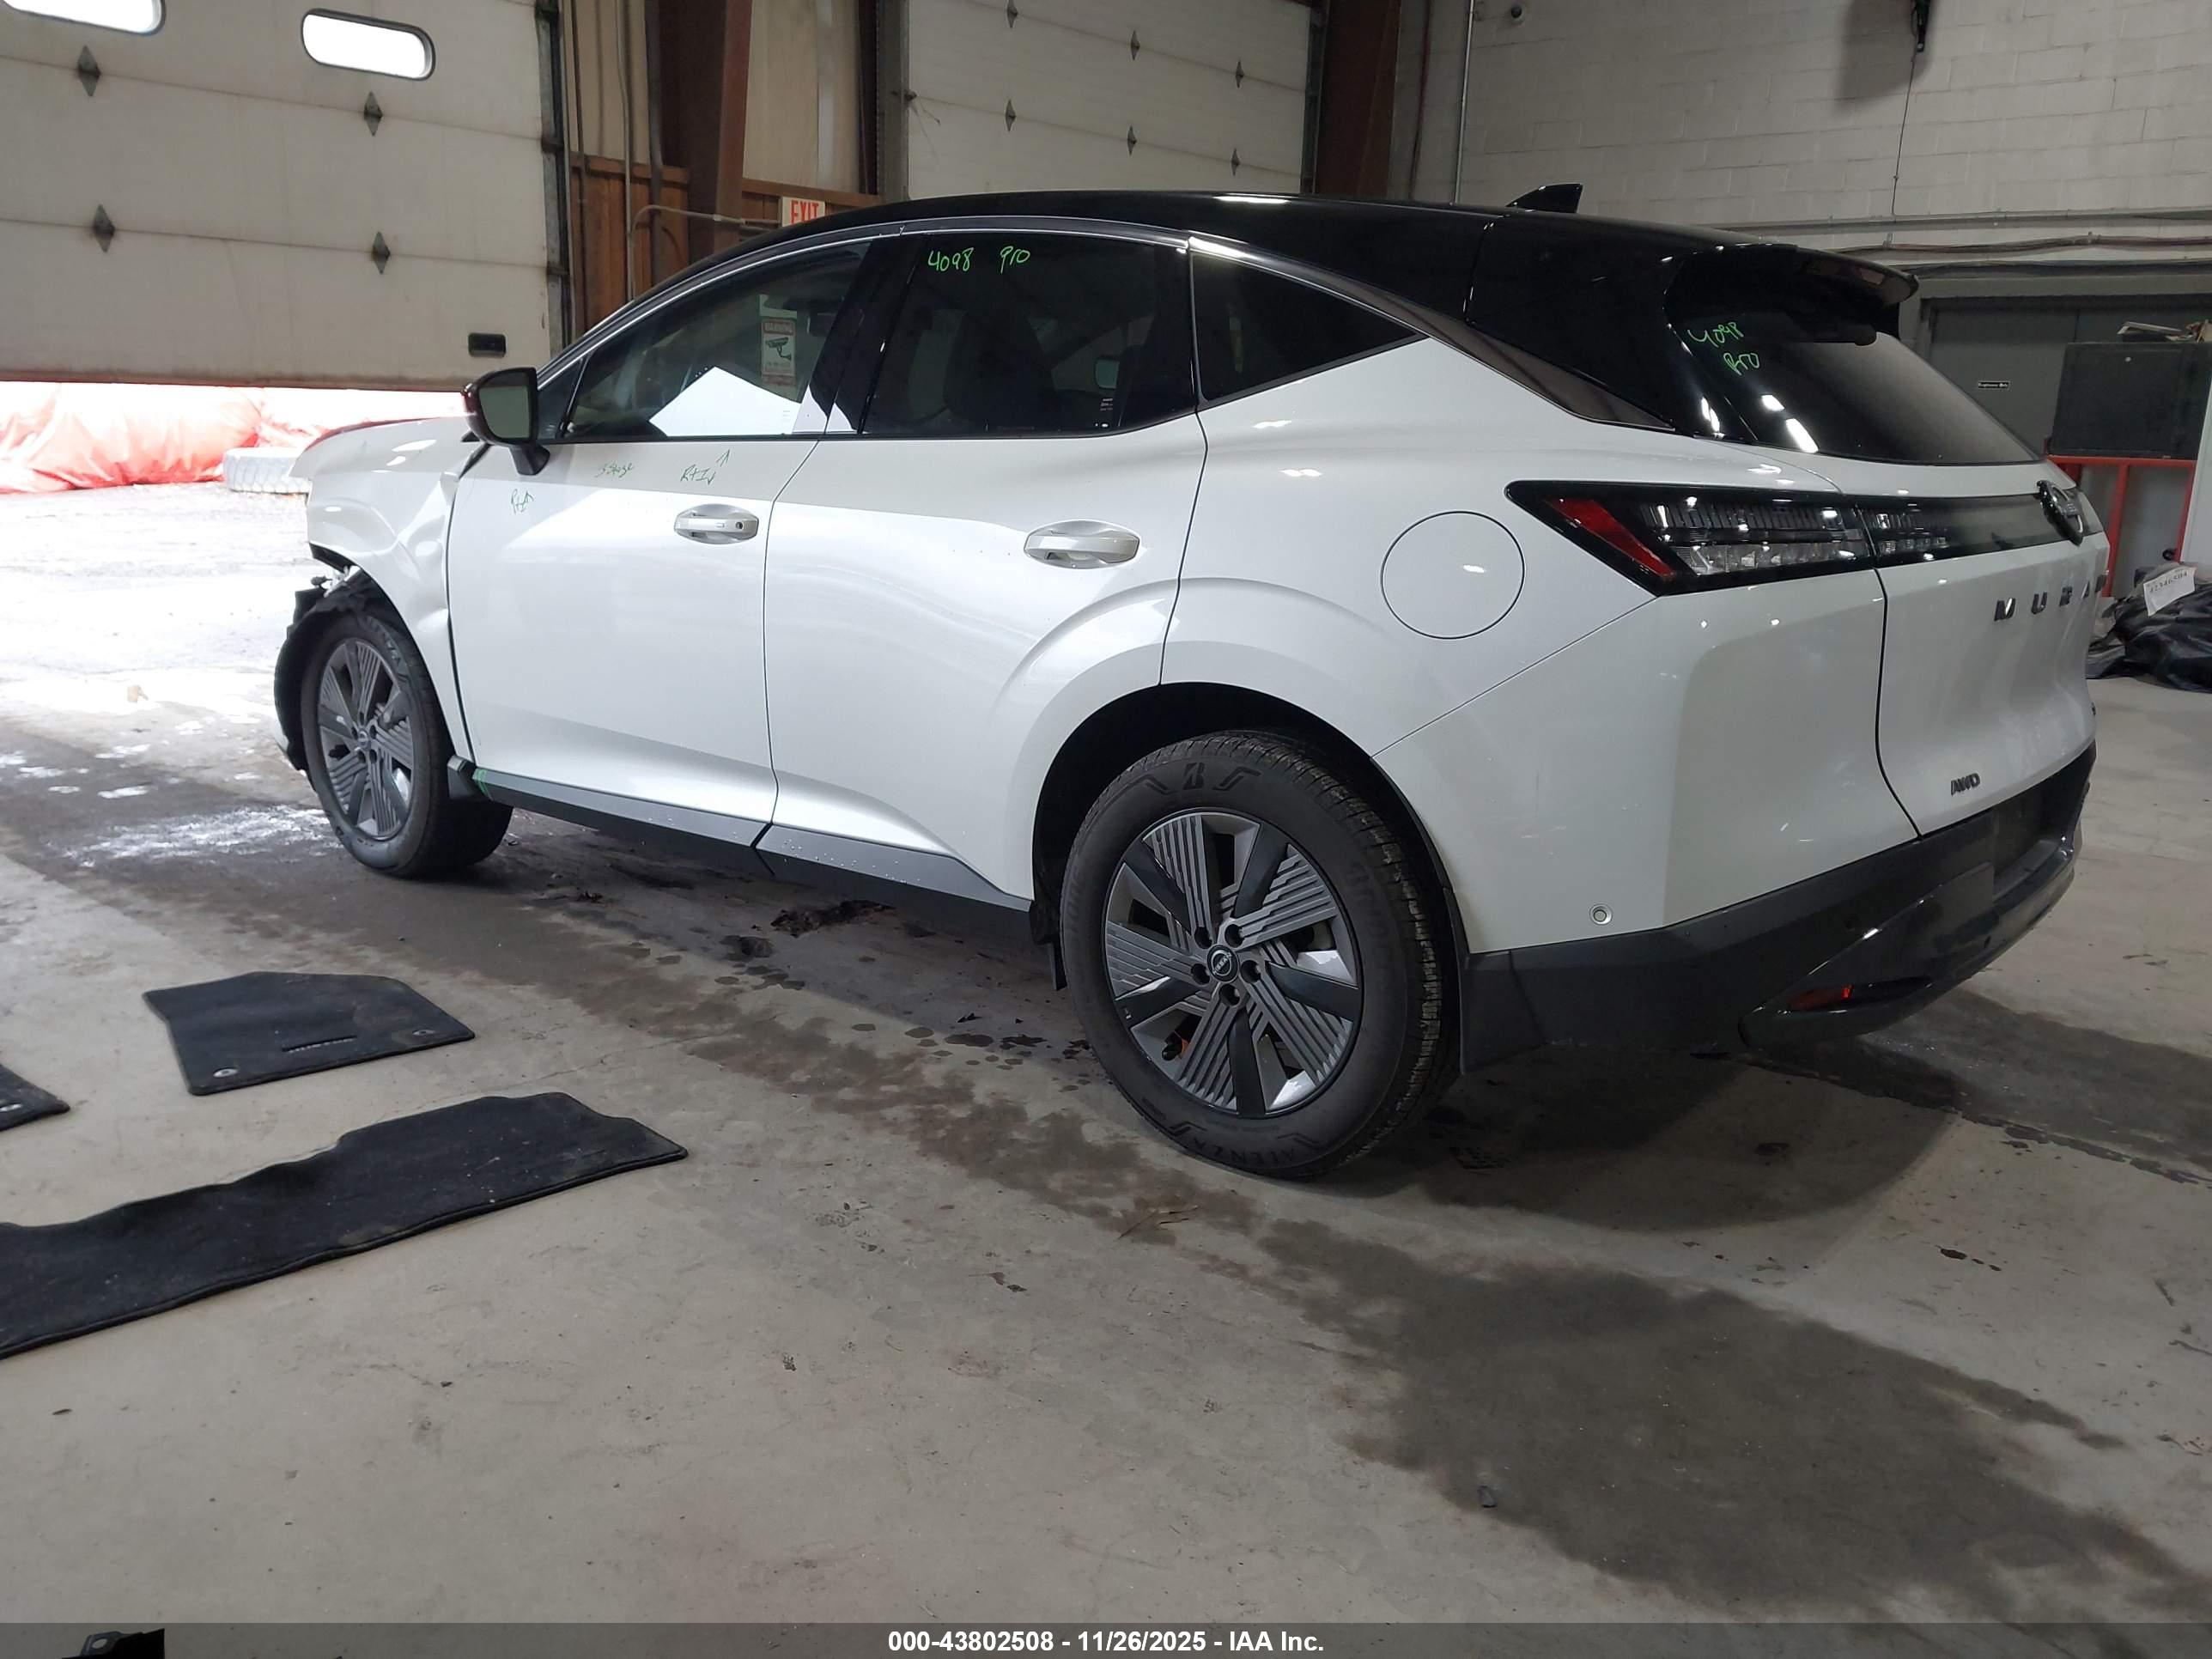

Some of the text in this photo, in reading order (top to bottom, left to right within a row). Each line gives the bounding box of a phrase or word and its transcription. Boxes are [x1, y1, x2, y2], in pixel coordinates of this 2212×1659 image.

[791, 199, 819, 226] EXIT
[927, 246, 975, 271] 4098
[1686, 321, 1745, 348] 4098
[1950, 772, 1981, 797] AWD
